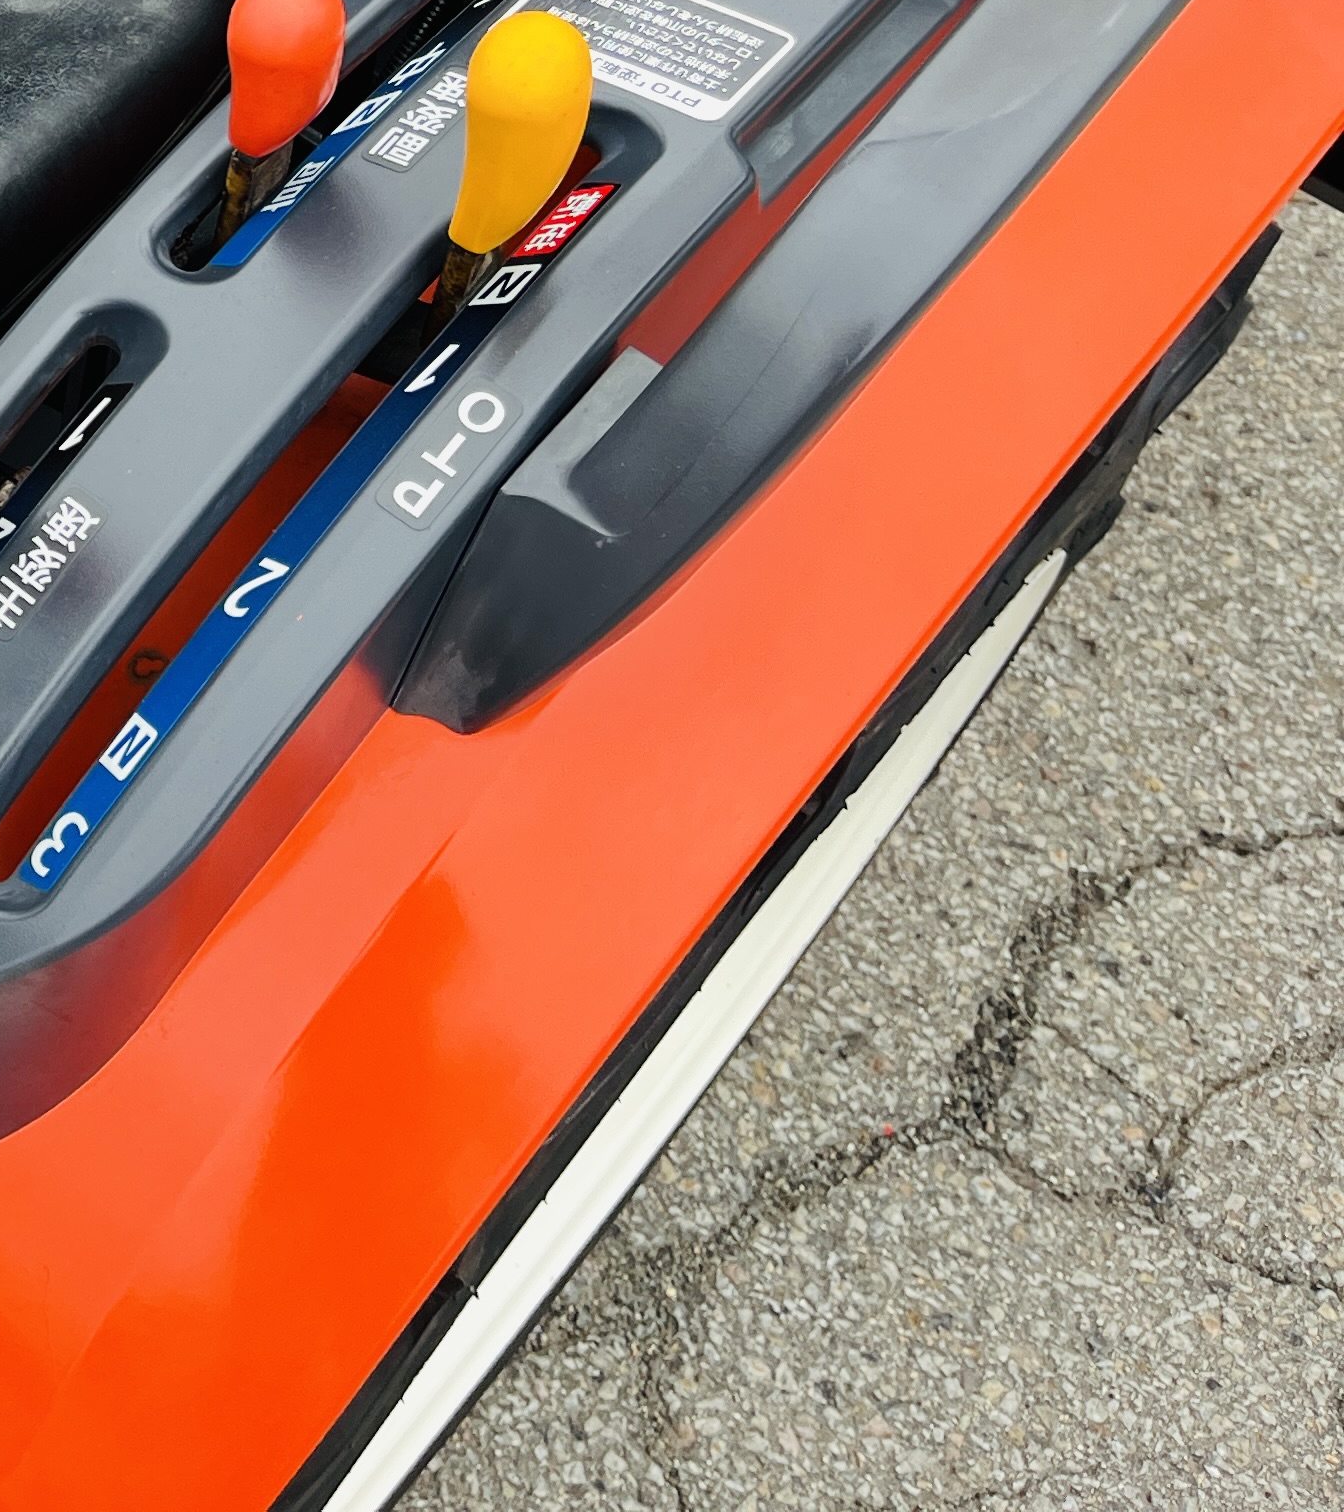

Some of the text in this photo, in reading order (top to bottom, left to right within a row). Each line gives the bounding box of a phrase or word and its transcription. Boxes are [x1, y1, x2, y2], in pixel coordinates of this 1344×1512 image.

[369, 71, 468, 167] 副変速
[262, 157, 336, 213] 高
[57, 397, 112, 452] 1
[381, 390, 507, 521] PTO
[30, 191, 603, 878] 逆転 N 1 2 N 3
